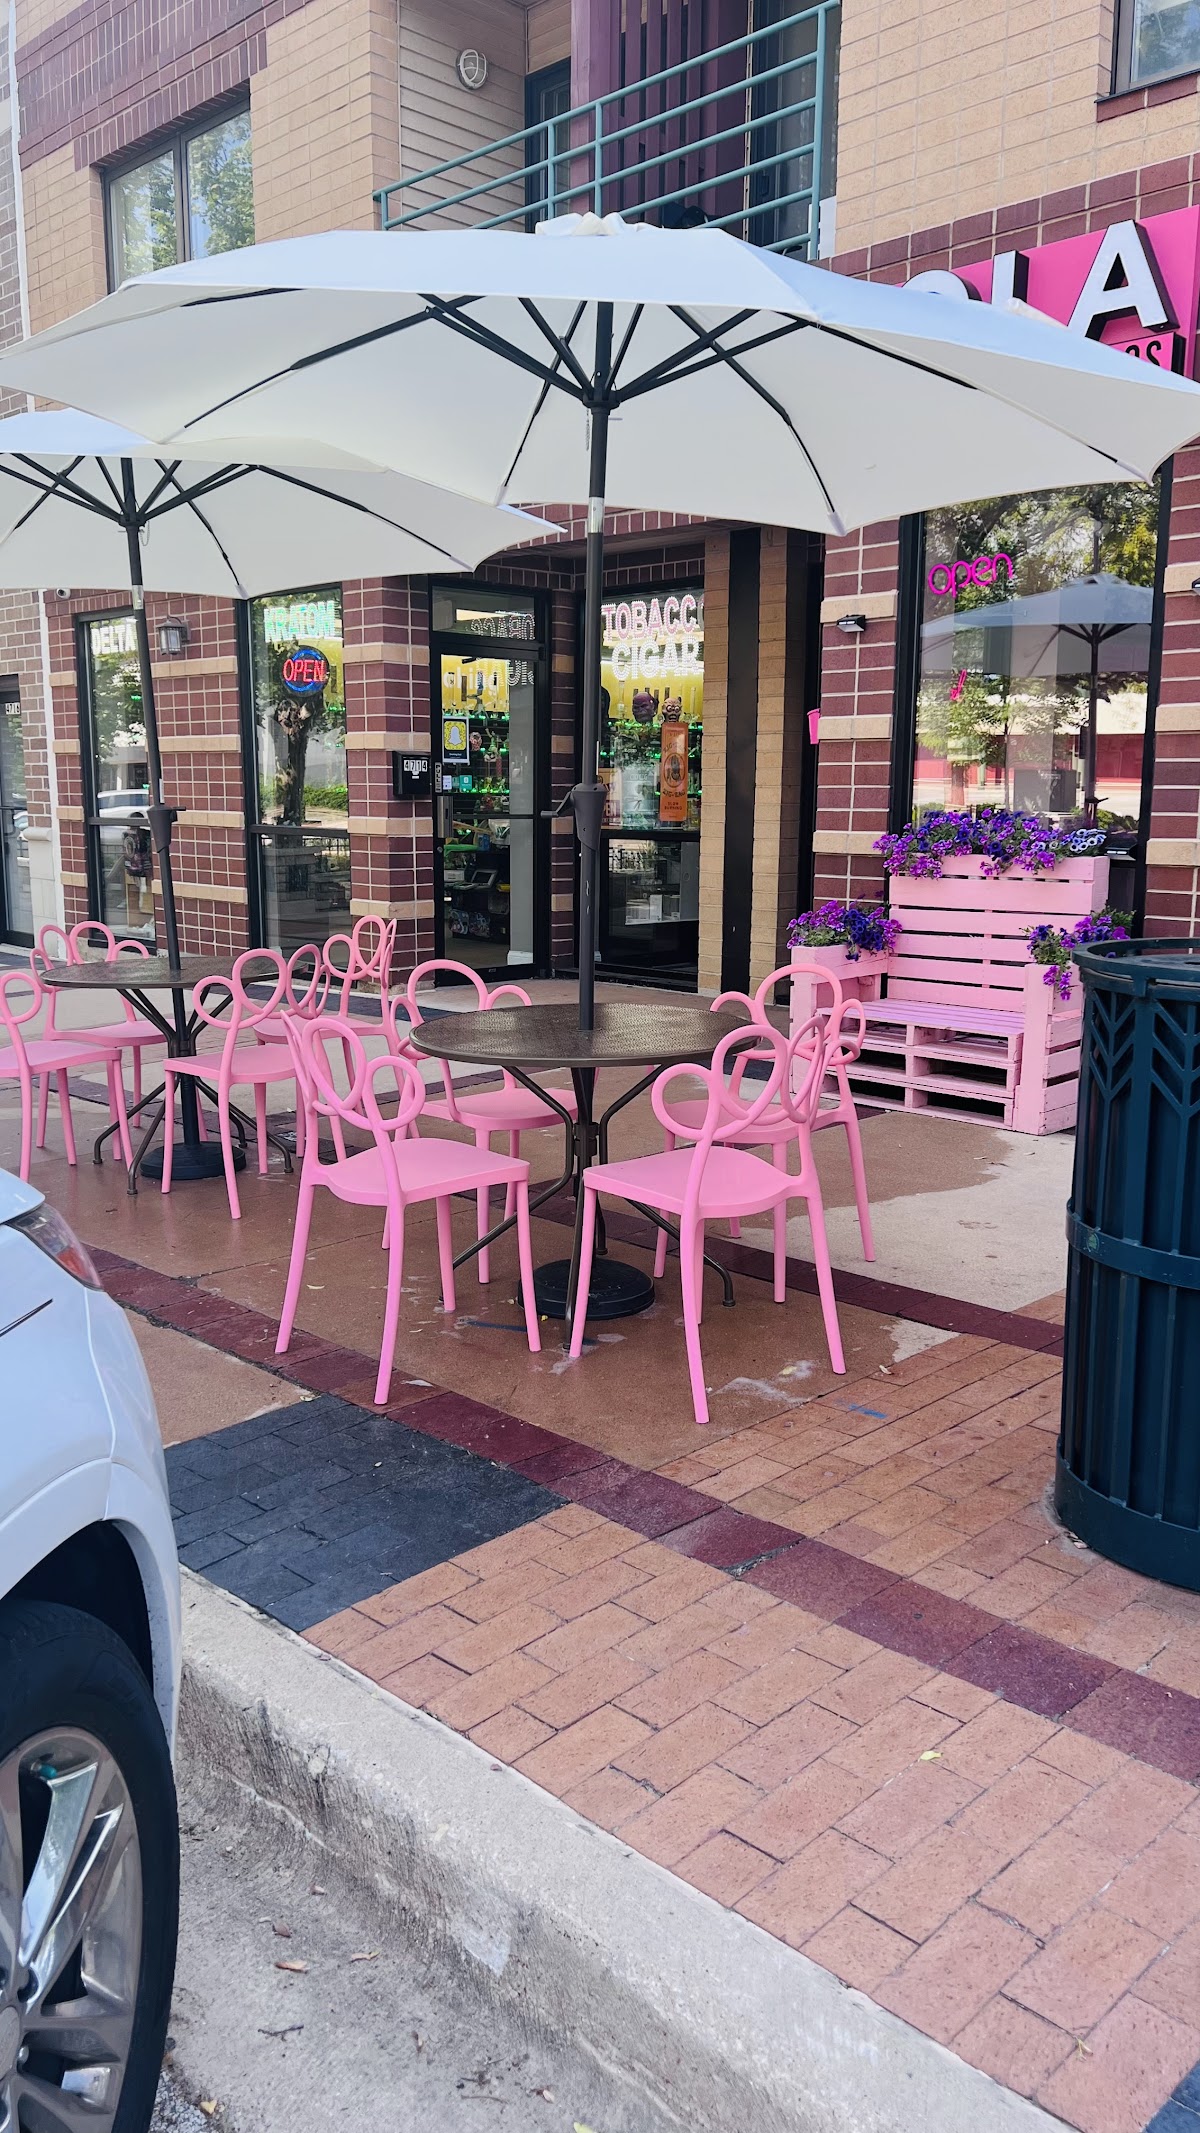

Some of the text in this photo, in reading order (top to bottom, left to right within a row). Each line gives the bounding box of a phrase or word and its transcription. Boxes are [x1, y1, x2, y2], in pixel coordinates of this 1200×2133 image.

[928, 552, 1013, 598] open
[263, 600, 335, 643] KRATOM
[601, 594, 704, 642] TOBACC
[91, 623, 137, 655] DELTA
[283, 659, 326, 682] OPEN
[612, 636, 700, 680] CIGAR
[6, 703, 20, 714] 4716
[404, 760, 427, 772] 4714
